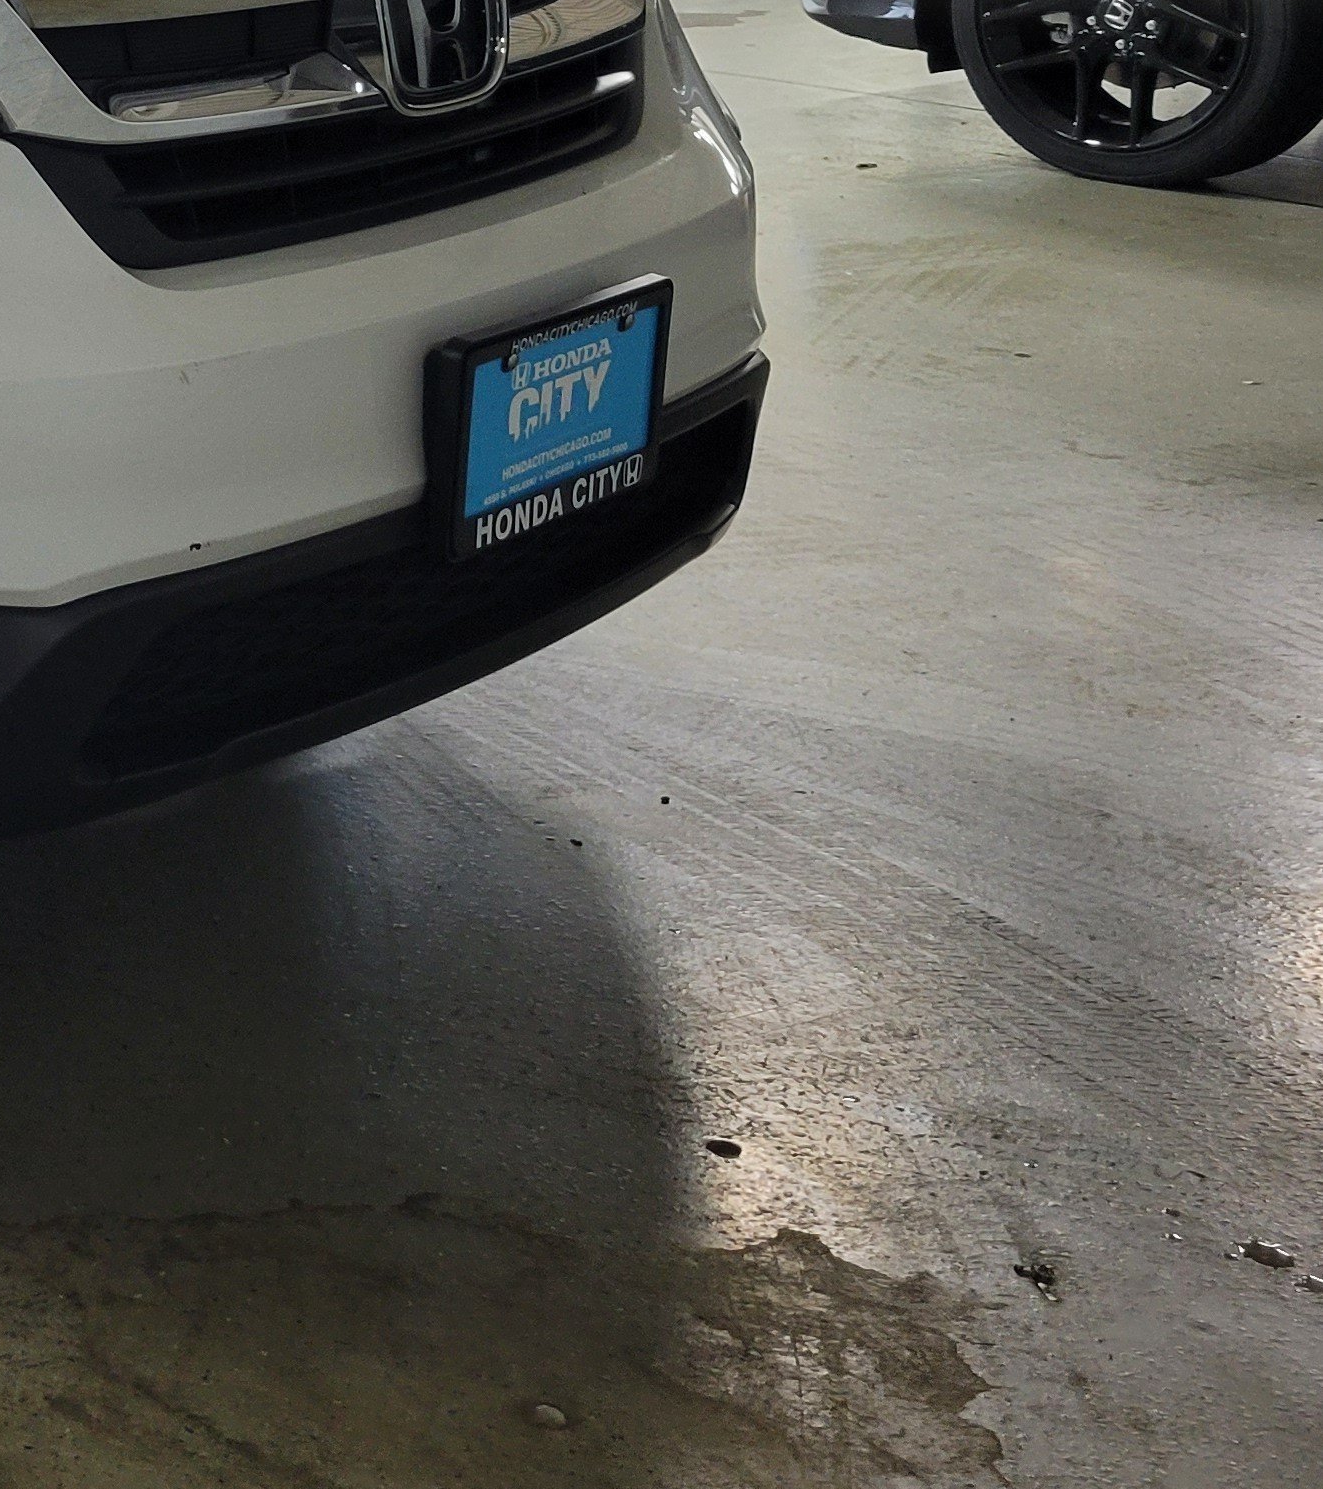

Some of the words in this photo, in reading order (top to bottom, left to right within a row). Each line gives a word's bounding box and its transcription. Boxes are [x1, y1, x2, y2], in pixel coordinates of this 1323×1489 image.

[511, 301, 638, 354] HONDACITYCHICAGO.COM
[533, 337, 613, 380] HONDA
[508, 359, 612, 443] CITY
[501, 427, 612, 481] HONDACITYCHICAGO.COM
[475, 487, 564, 549] HONDA
[571, 461, 624, 510] CITY
